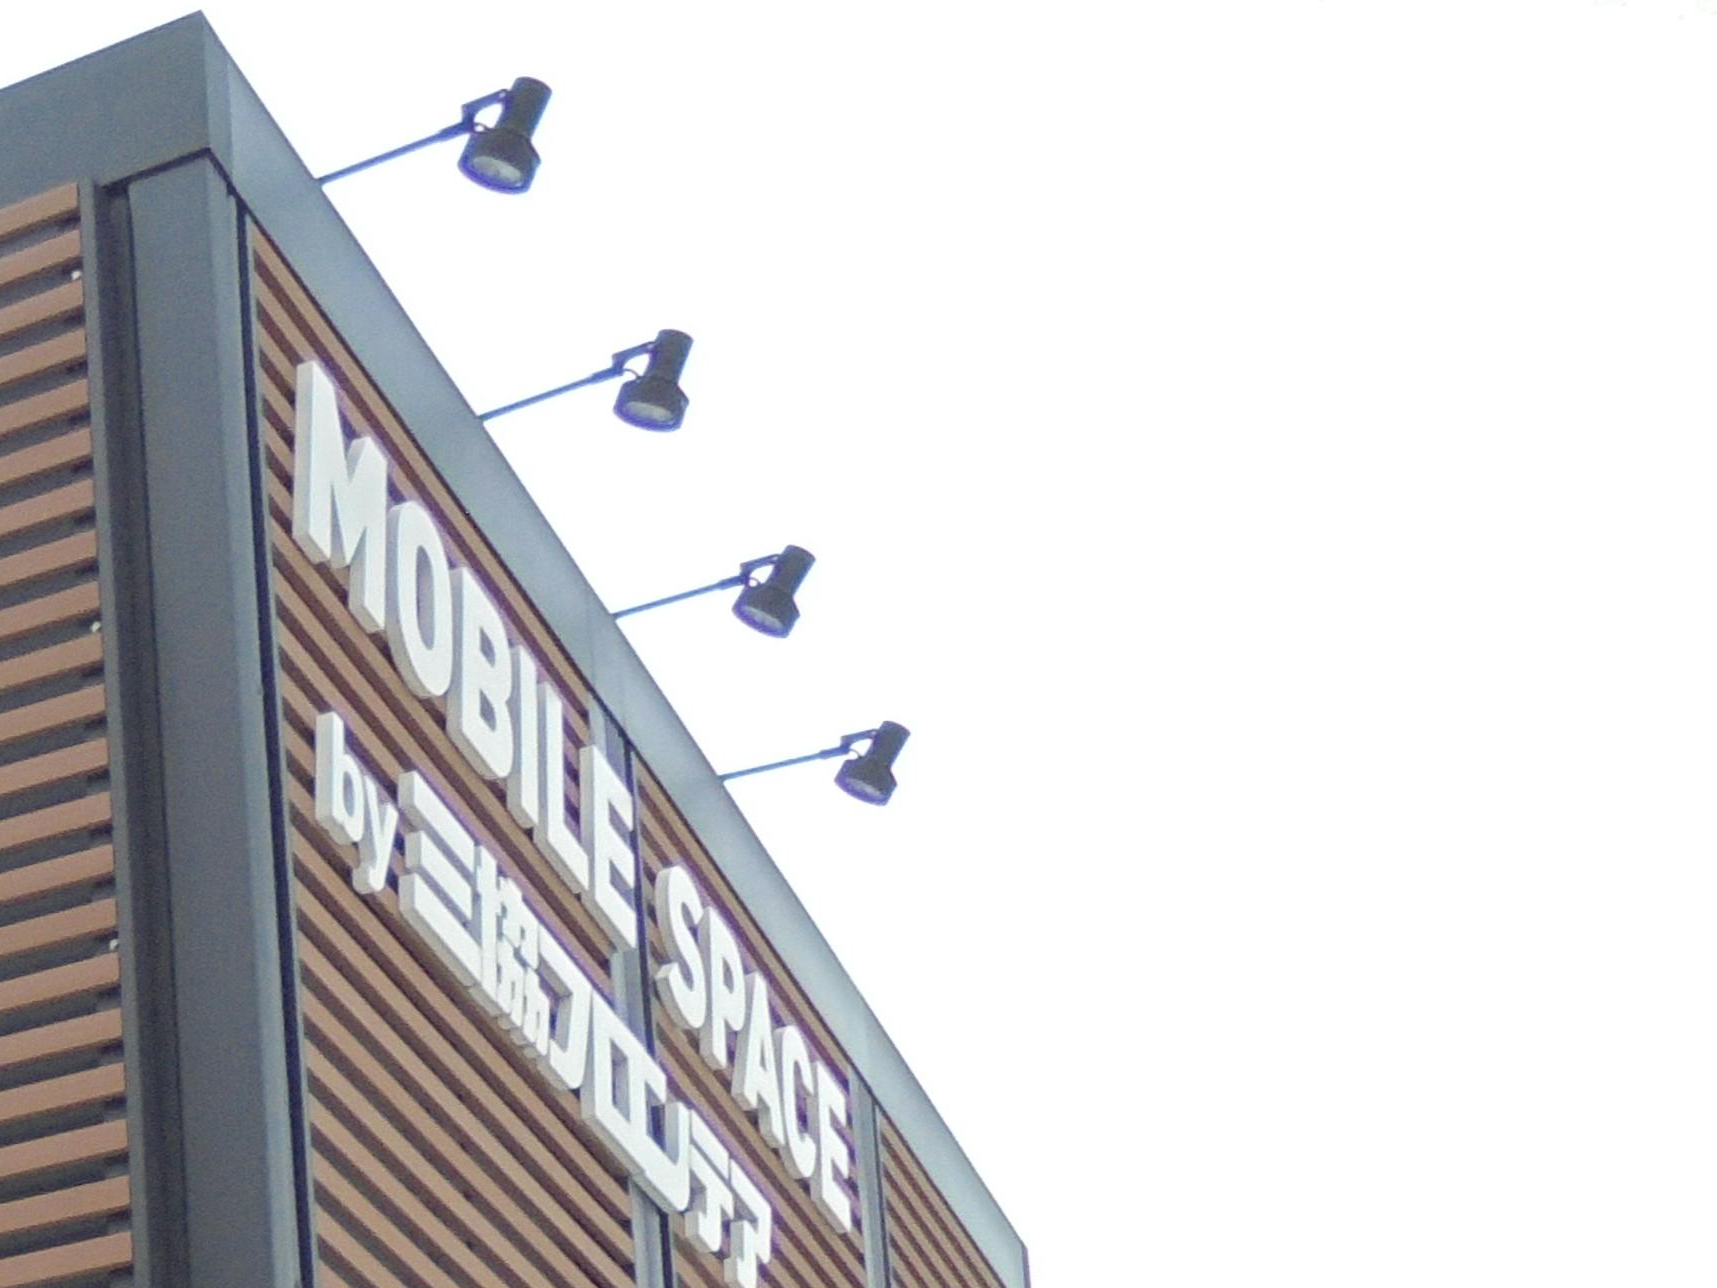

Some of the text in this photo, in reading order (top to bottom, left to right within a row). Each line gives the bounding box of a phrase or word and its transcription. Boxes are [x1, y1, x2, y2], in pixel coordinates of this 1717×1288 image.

[293, 359, 853, 1234] MOBILE SPACE
[316, 709, 398, 894] by
